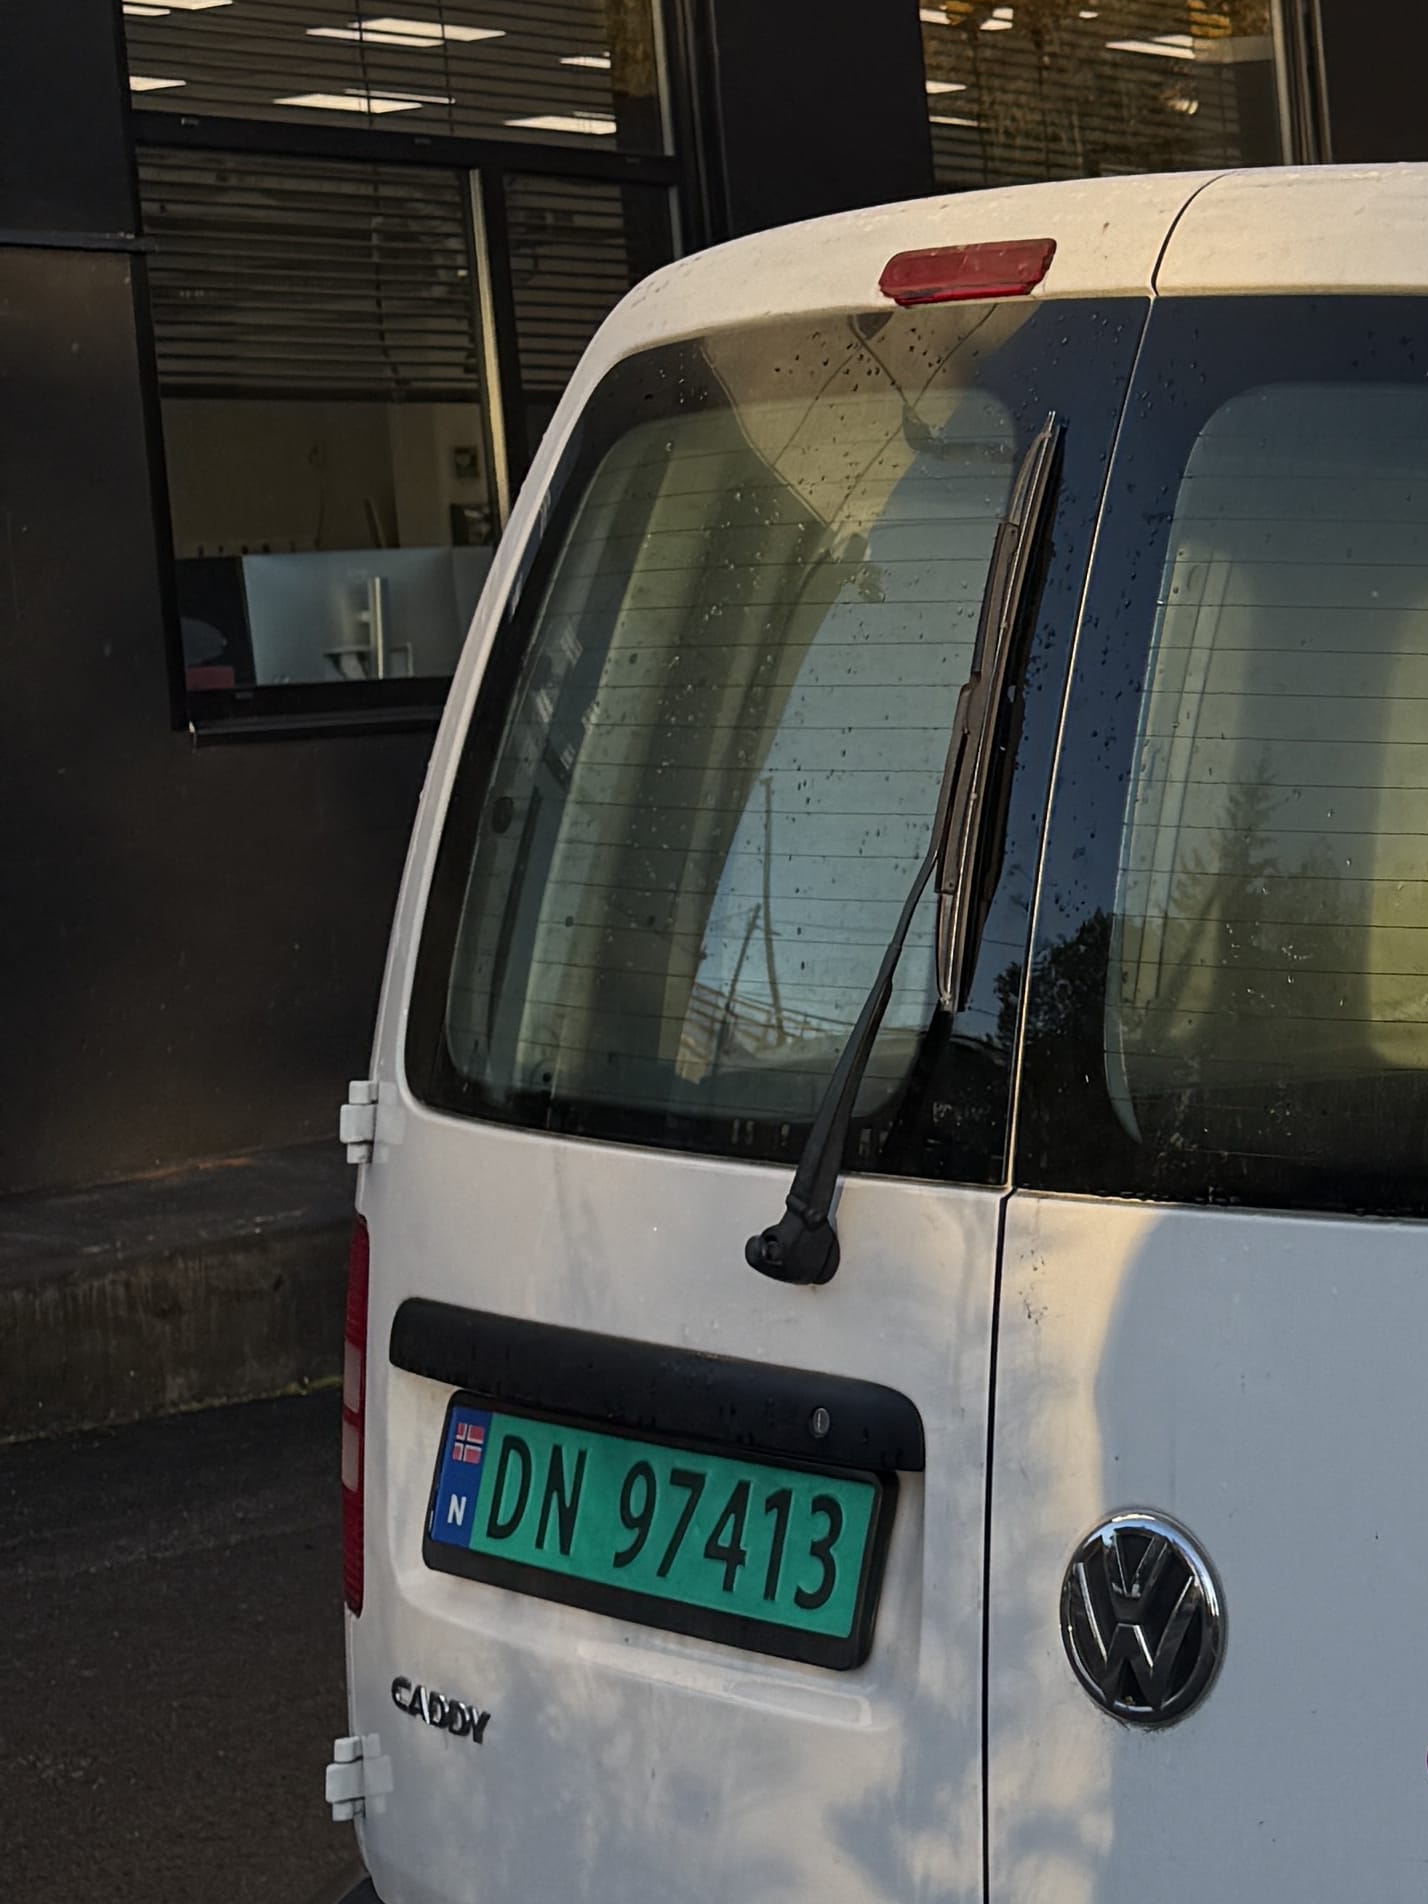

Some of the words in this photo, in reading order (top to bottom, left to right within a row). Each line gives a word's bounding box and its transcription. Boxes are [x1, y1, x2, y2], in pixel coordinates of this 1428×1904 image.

[446, 1493, 467, 1527] N
[486, 1434, 588, 1556] DN
[613, 1460, 844, 1611] 97413
[391, 1674, 492, 1745] CADDY
